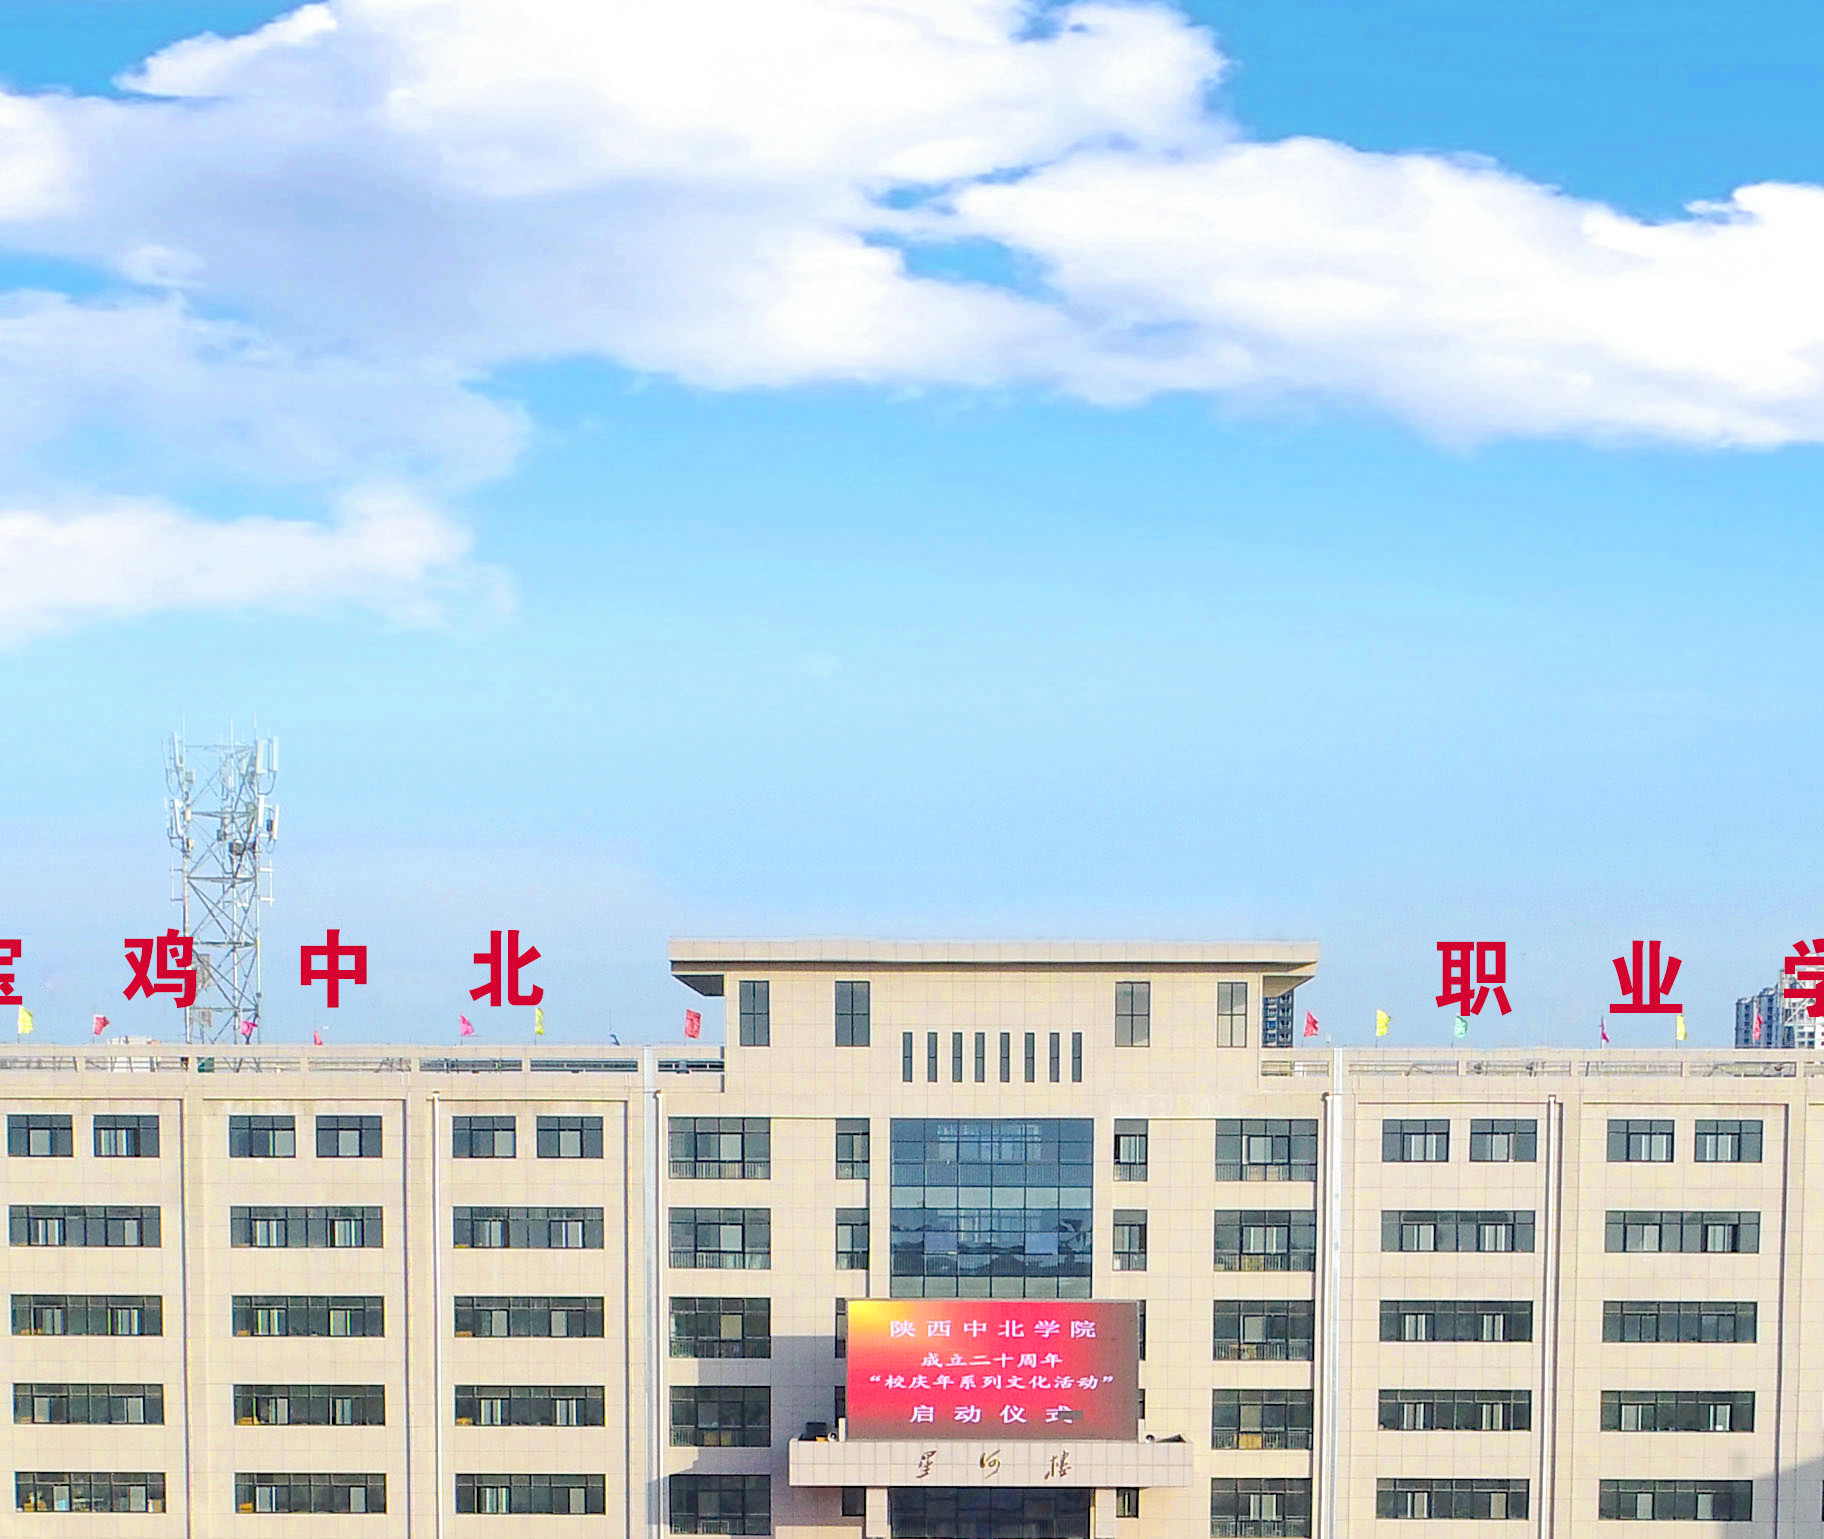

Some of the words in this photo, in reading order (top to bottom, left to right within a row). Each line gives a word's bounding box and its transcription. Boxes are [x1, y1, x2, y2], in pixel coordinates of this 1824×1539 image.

[889, 1318, 1097, 1340] 陕西中北学院
[921, 1351, 1064, 1369] 成立二十周年
[909, 1404, 1074, 1425] 启动仪式
[916, 1449, 1072, 1480] 星河楼
